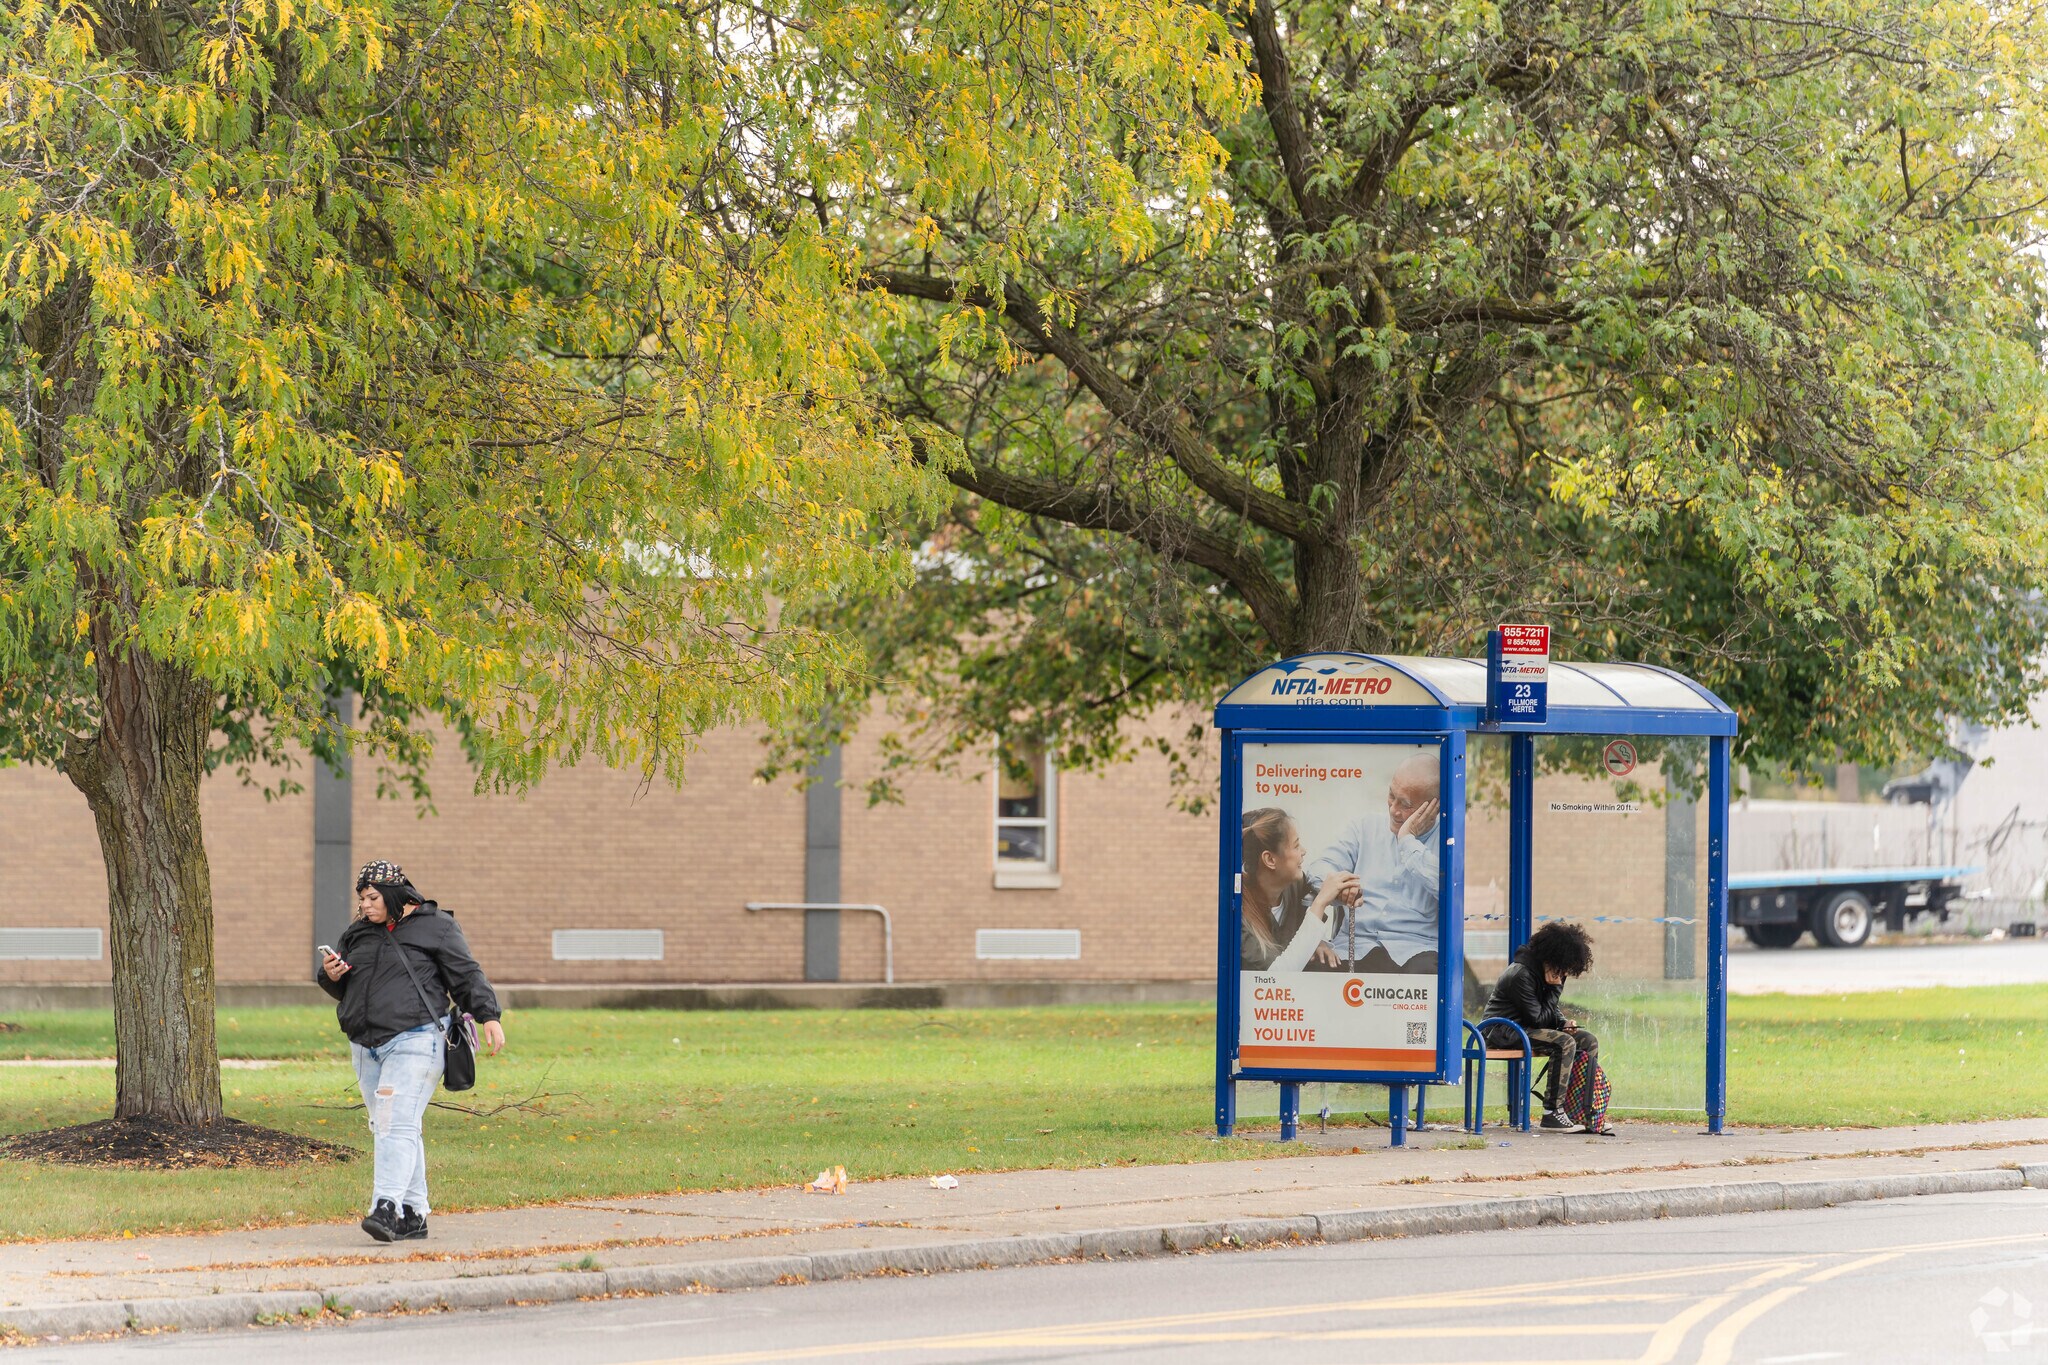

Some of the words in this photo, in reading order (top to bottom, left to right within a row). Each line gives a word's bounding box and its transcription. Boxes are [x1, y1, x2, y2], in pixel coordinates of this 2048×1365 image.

[1504, 627, 1544, 638] 855-7211
[1271, 677, 1392, 695] NFTA-METRO
[1515, 684, 1531, 698] 23
[1296, 696, 1364, 706] nfta.com
[1508, 698, 1538, 706] FILLMORE
[1256, 764, 1327, 781] Delivering
[1330, 766, 1363, 779] care
[1256, 781, 1270, 794] to
[1274, 783, 1302, 797] you.
[1551, 803, 1561, 811] No
[1562, 803, 1592, 812] Smoking
[1593, 803, 1615, 811] Within
[1254, 976, 1276, 984] That's
[1254, 987, 1295, 1003] CARE,
[1364, 987, 1428, 1000] CINQCARE
[1392, 1003, 1428, 1011] CINQ.CARE
[1254, 1007, 1304, 1022] WHERE
[1254, 1027, 1284, 1042] YOU
[1287, 1028, 1316, 1042] LIVE
